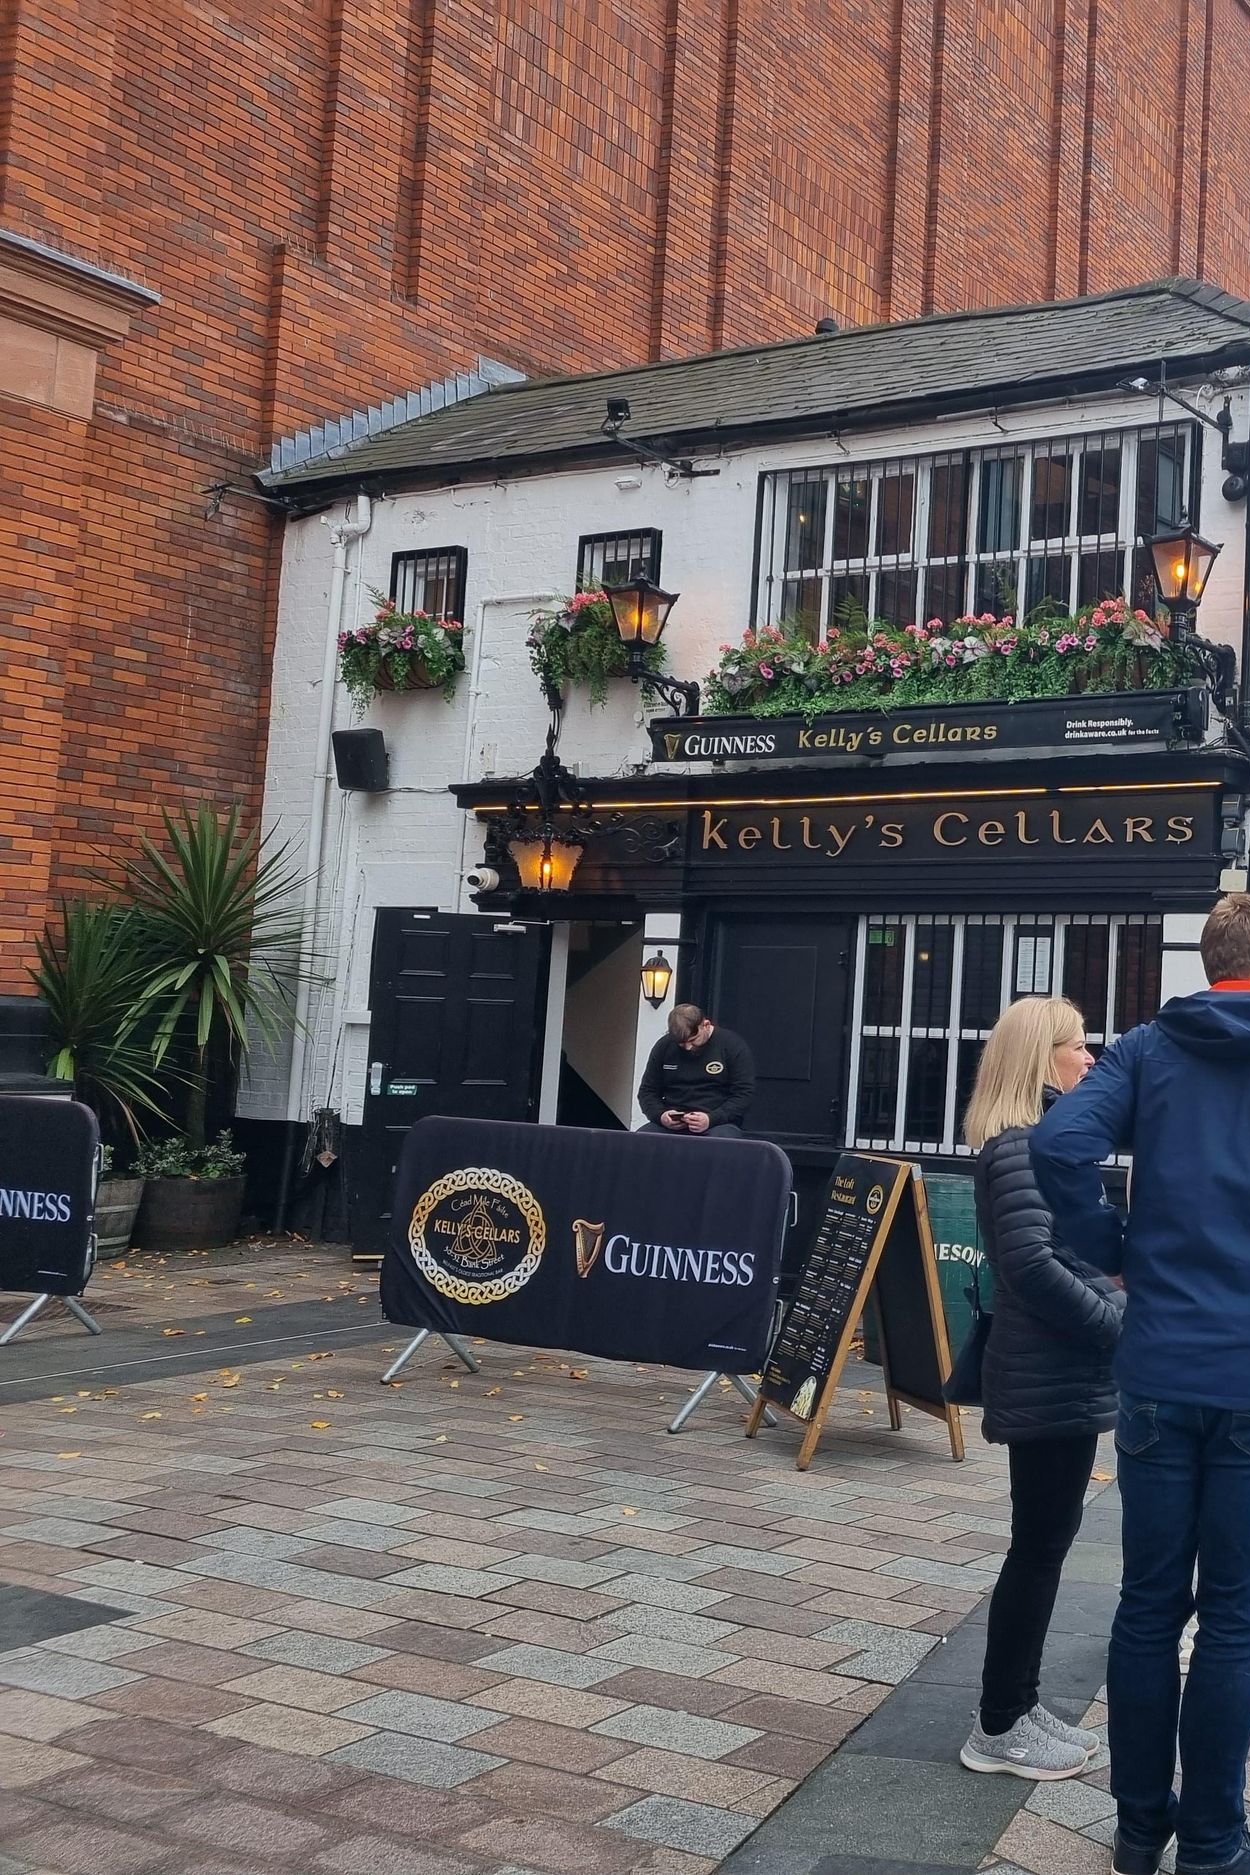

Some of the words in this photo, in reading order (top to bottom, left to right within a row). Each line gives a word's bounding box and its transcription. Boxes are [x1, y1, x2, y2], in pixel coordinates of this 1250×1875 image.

[1066, 720, 1087, 728] Drink
[1088, 718, 1134, 729] Responsibly.
[684, 734, 776, 756] GUINNESS
[798, 727, 882, 752] Kelly's
[892, 723, 997, 744] Cellars
[1064, 728, 1127, 739] drinkaware.co.uk
[844, 1178, 855, 1190] Loft
[831, 1189, 856, 1205] Restaurant
[434, 1219, 472, 1239] KELLY'S
[474, 1225, 521, 1244] CELLARS
[460, 1255, 479, 1269] Bank
[480, 1253, 504, 1270] Street
[604, 1234, 756, 1287] GUINNESS
[933, 1243, 984, 1269] ESON
